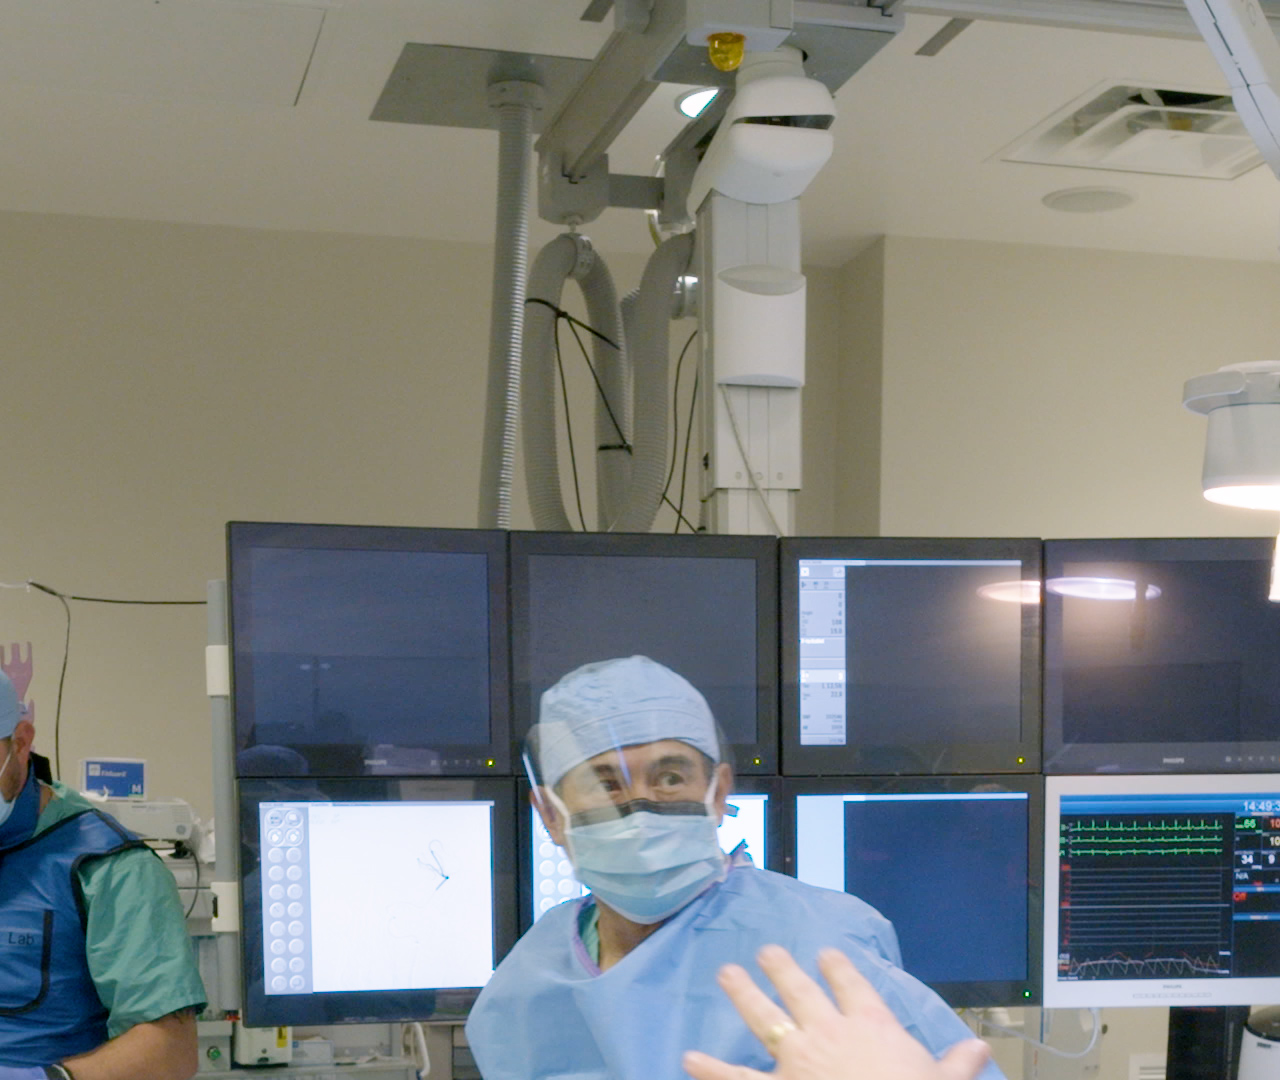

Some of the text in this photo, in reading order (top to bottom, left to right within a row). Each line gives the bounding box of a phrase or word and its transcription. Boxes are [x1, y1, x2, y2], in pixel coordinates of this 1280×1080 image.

[131, 783, 142, 794] M
[1241, 854, 1254, 865] 34
[8, 931, 35, 945] Lab
